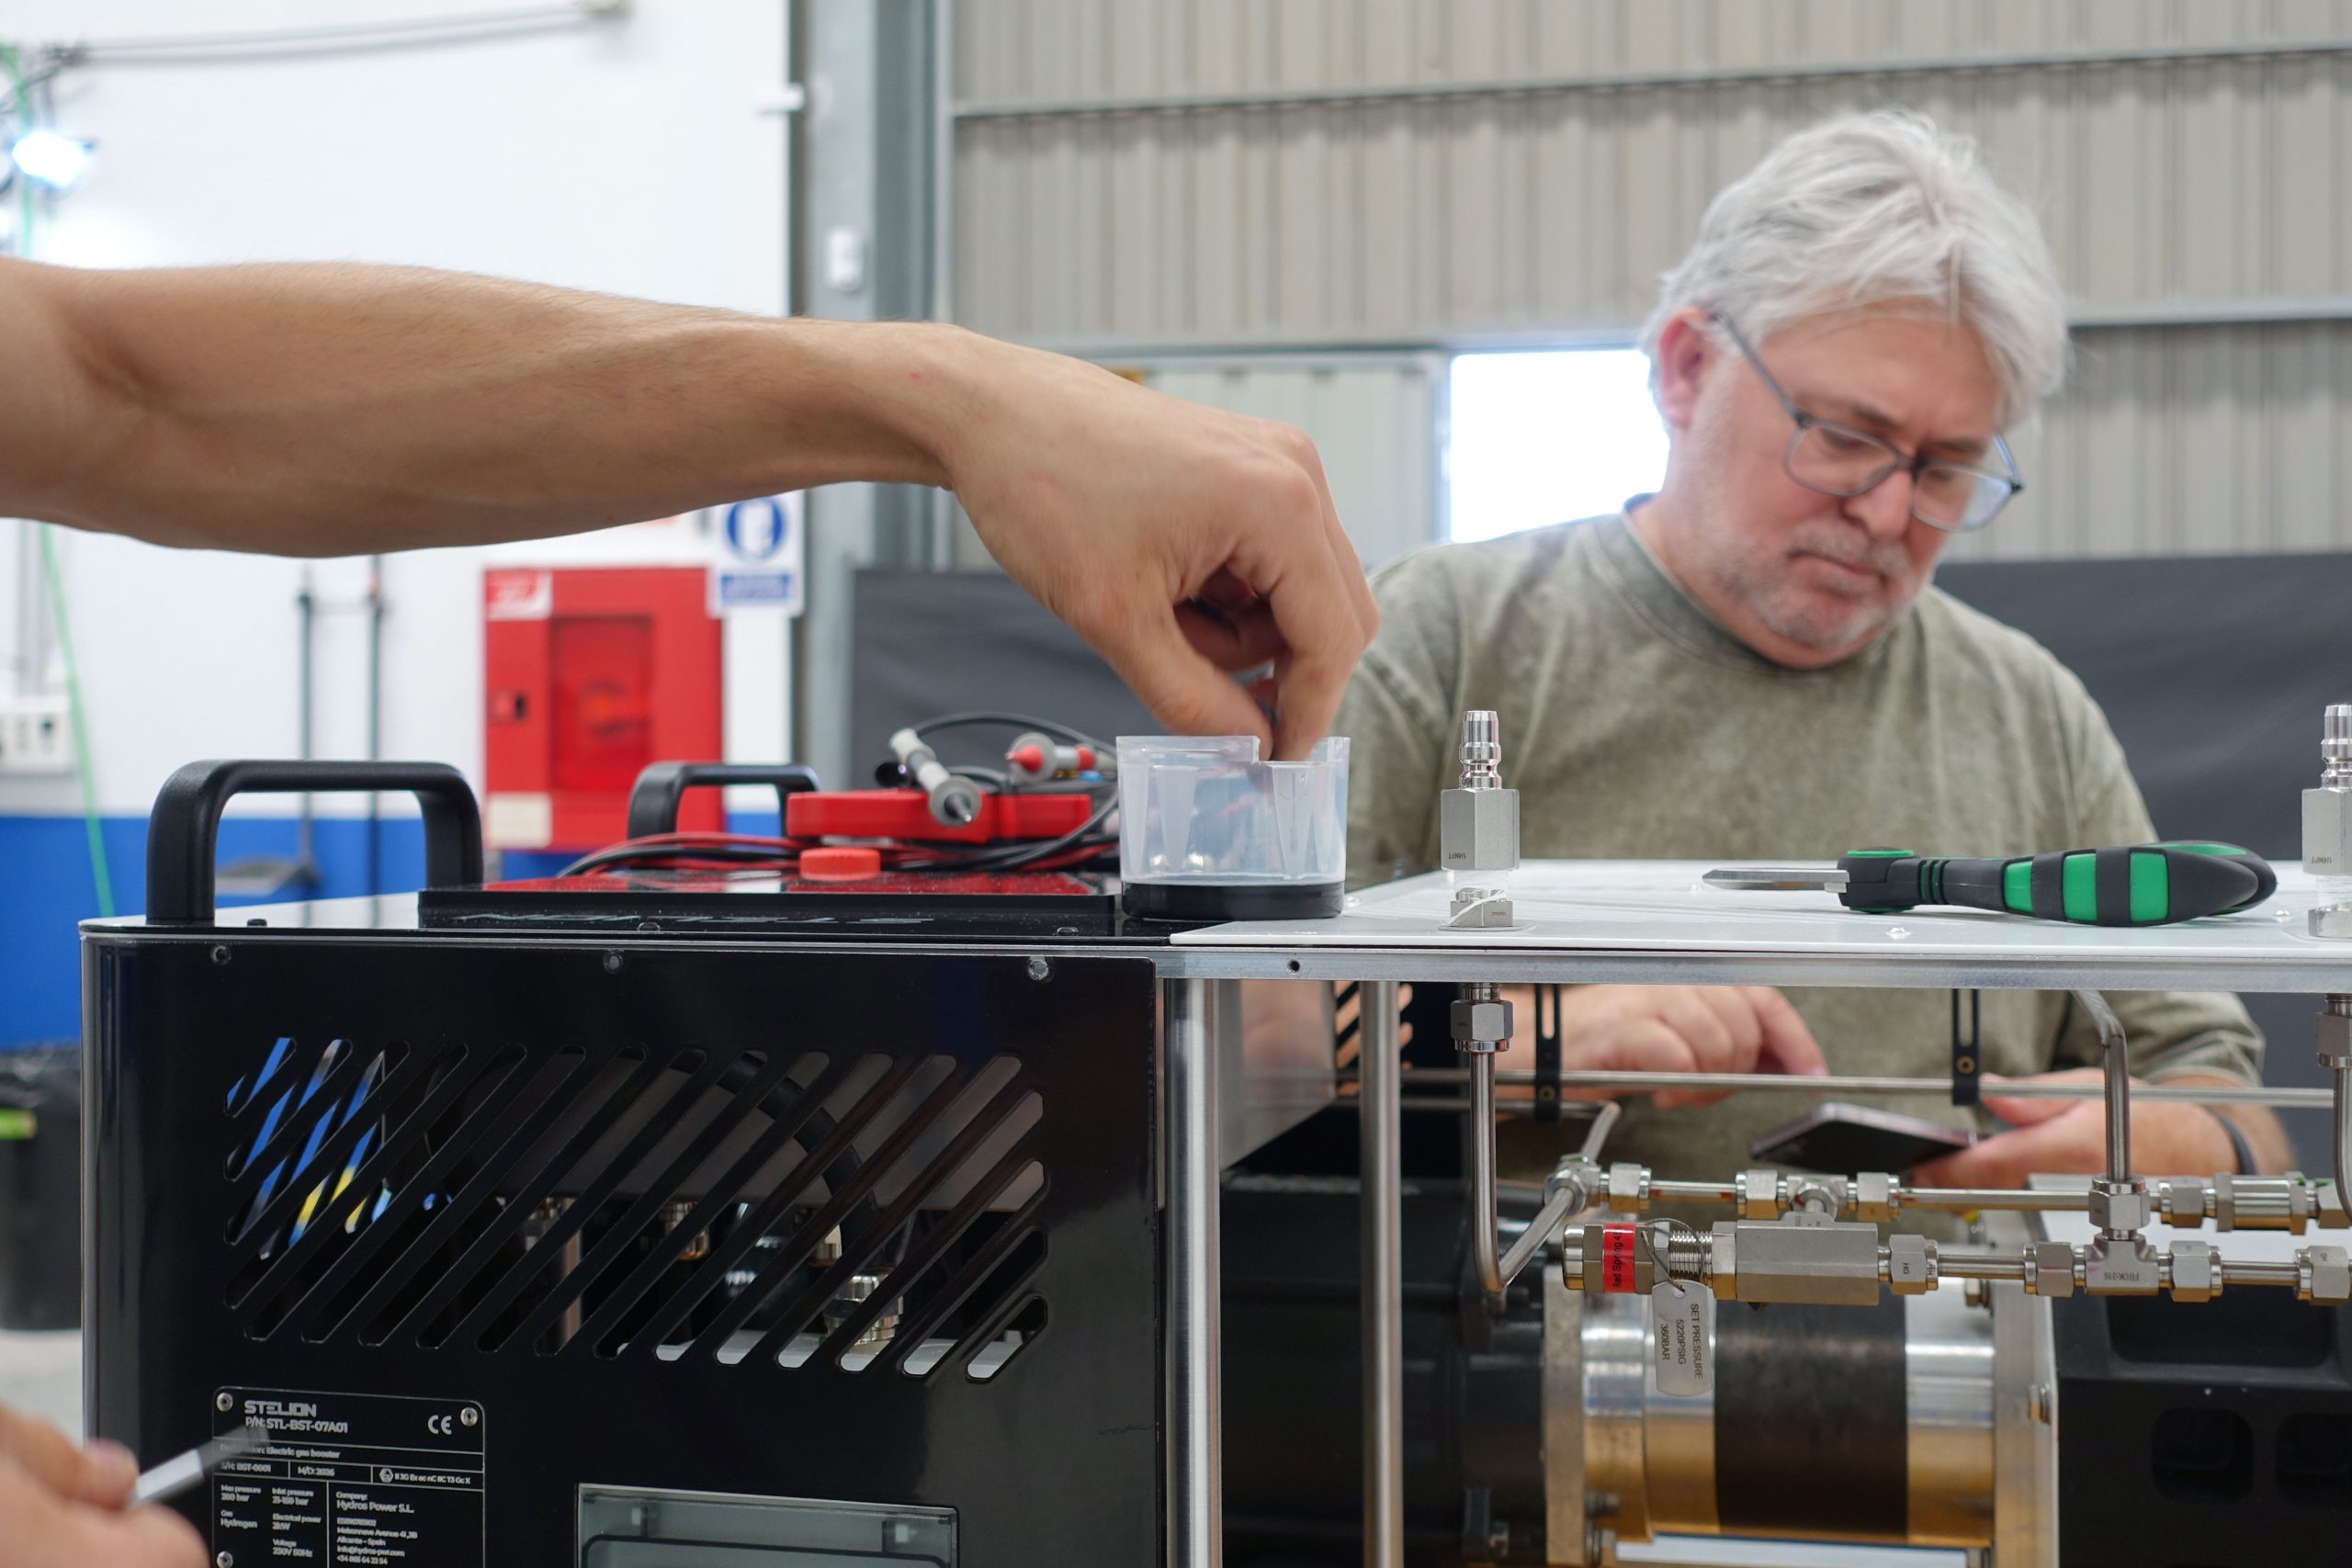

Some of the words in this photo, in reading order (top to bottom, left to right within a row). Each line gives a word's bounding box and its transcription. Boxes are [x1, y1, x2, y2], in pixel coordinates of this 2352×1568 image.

[1612, 1242, 1623, 1271] Spring
[1612, 1273, 1622, 1287] Red
[1690, 1303, 1700, 1322] SET
[1660, 1324, 1670, 1360] 360BAR
[1676, 1319, 1687, 1365] 5220PSIG
[1692, 1325, 1703, 1380] PRESSURE
[244, 1400, 317, 1417] STELION
[266, 1417, 348, 1433] STL-BST-07A01
[427, 1415, 452, 1435] CE
[266, 1446, 294, 1457] Electric
[296, 1449, 310, 1458] gas
[336, 1499, 368, 1511] Hydros
[369, 1501, 397, 1512] Power
[399, 1503, 414, 1514] S.L.
[220, 1517, 257, 1529] Hydrogen
